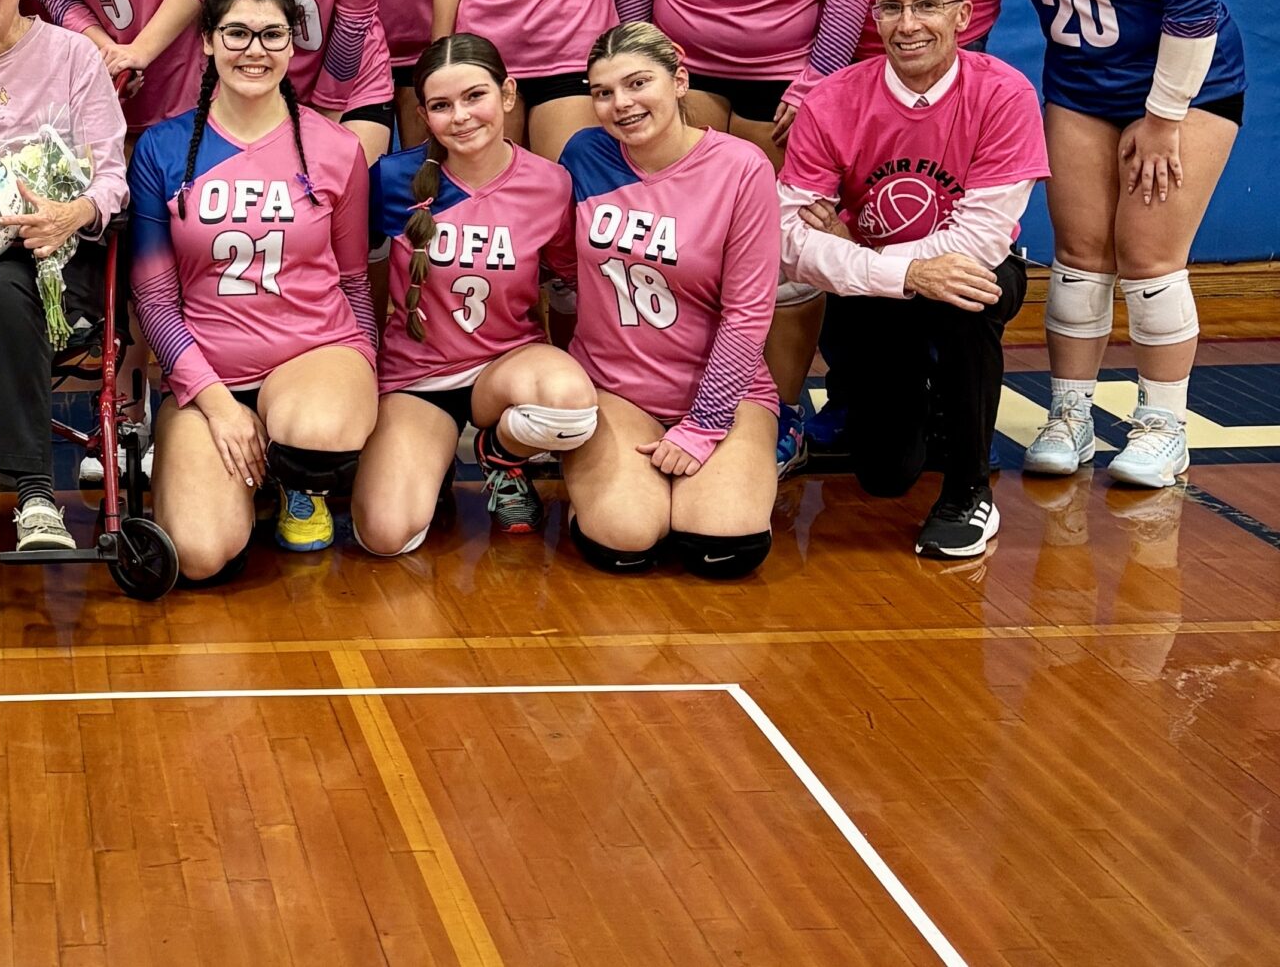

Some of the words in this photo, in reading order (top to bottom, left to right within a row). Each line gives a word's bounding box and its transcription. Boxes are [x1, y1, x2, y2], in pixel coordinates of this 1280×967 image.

[199, 178, 296, 225] OFA
[211, 229, 286, 298] 21
[427, 222, 518, 271] OFA
[589, 202, 679, 266] OFA
[449, 275, 492, 334] 3
[599, 256, 679, 330] 18
